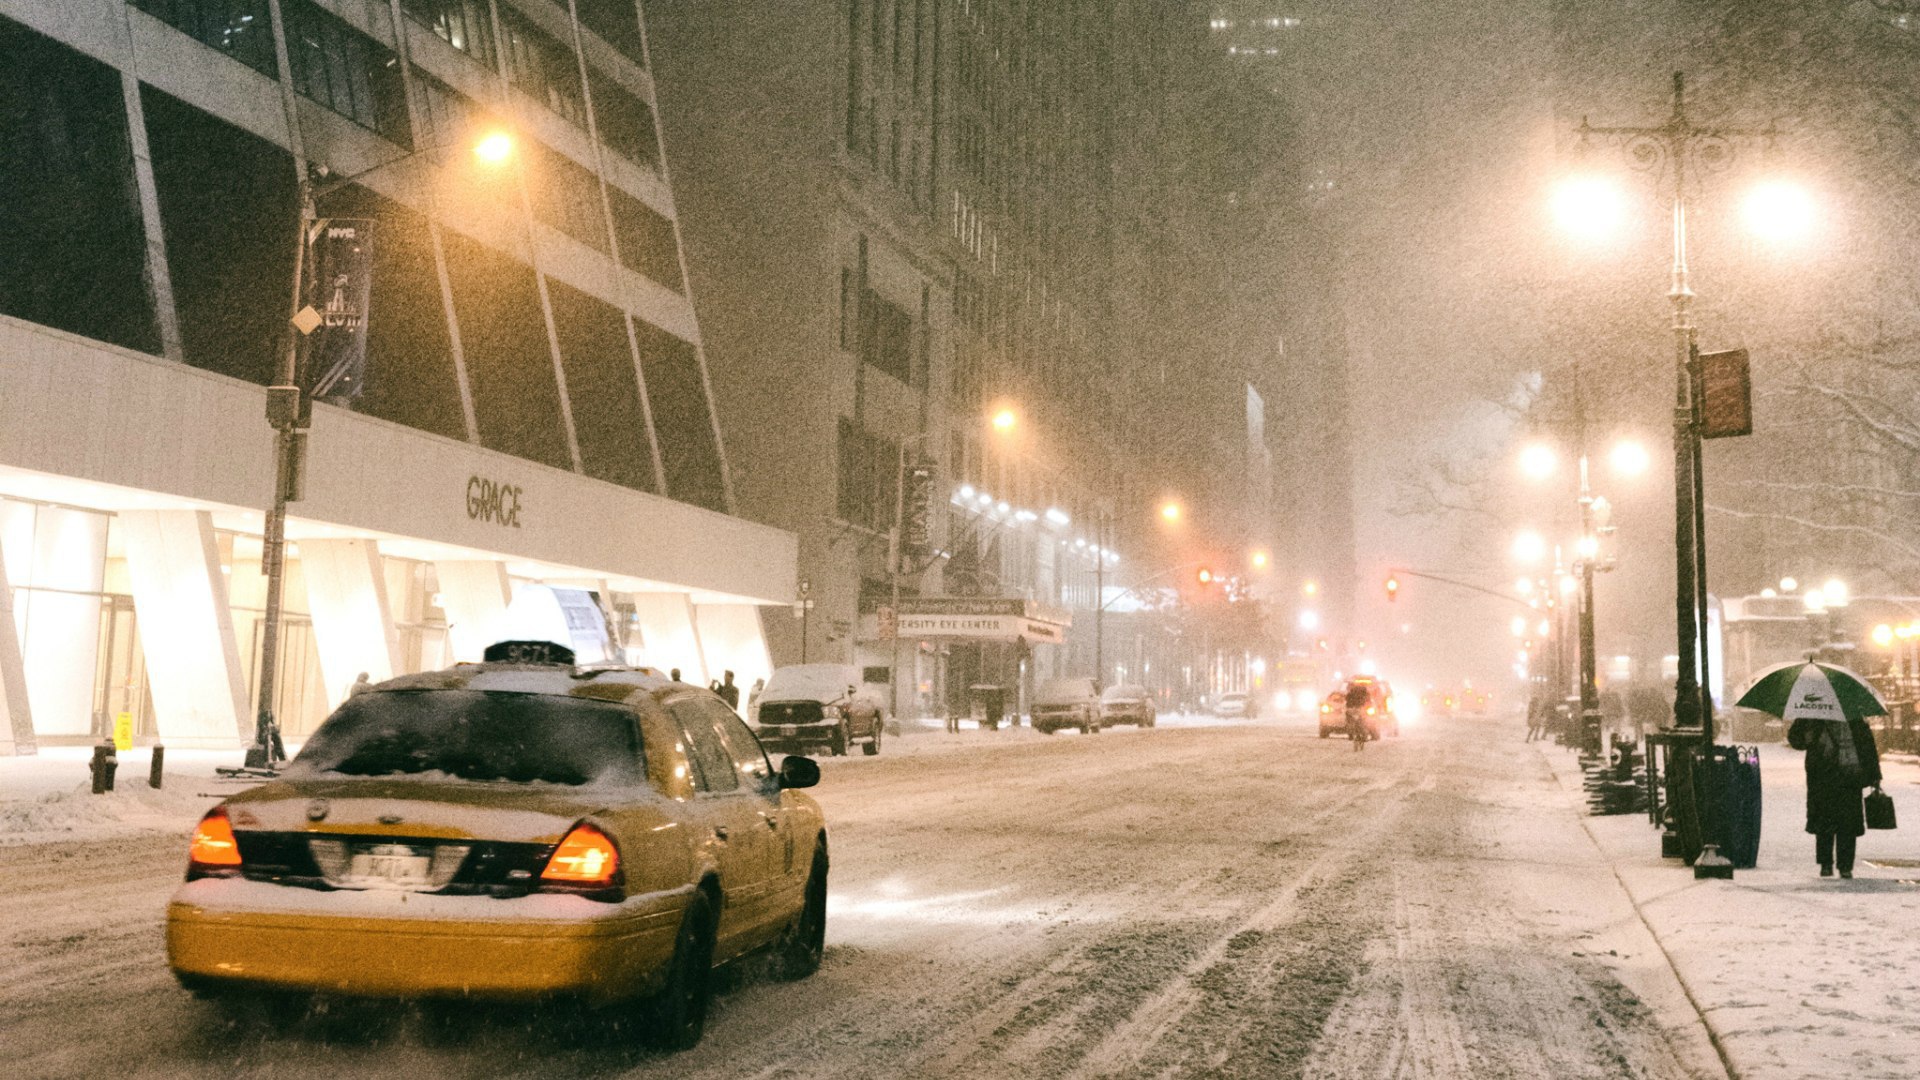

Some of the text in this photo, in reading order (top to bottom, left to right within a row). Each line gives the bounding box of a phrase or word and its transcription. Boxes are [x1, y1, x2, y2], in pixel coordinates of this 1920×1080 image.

[321, 314, 362, 327] LVIII
[466, 475, 523, 529] GRACE
[940, 619, 958, 630] EYE
[961, 619, 1000, 630] CENTER
[1794, 703, 1834, 711] LACOSTE
